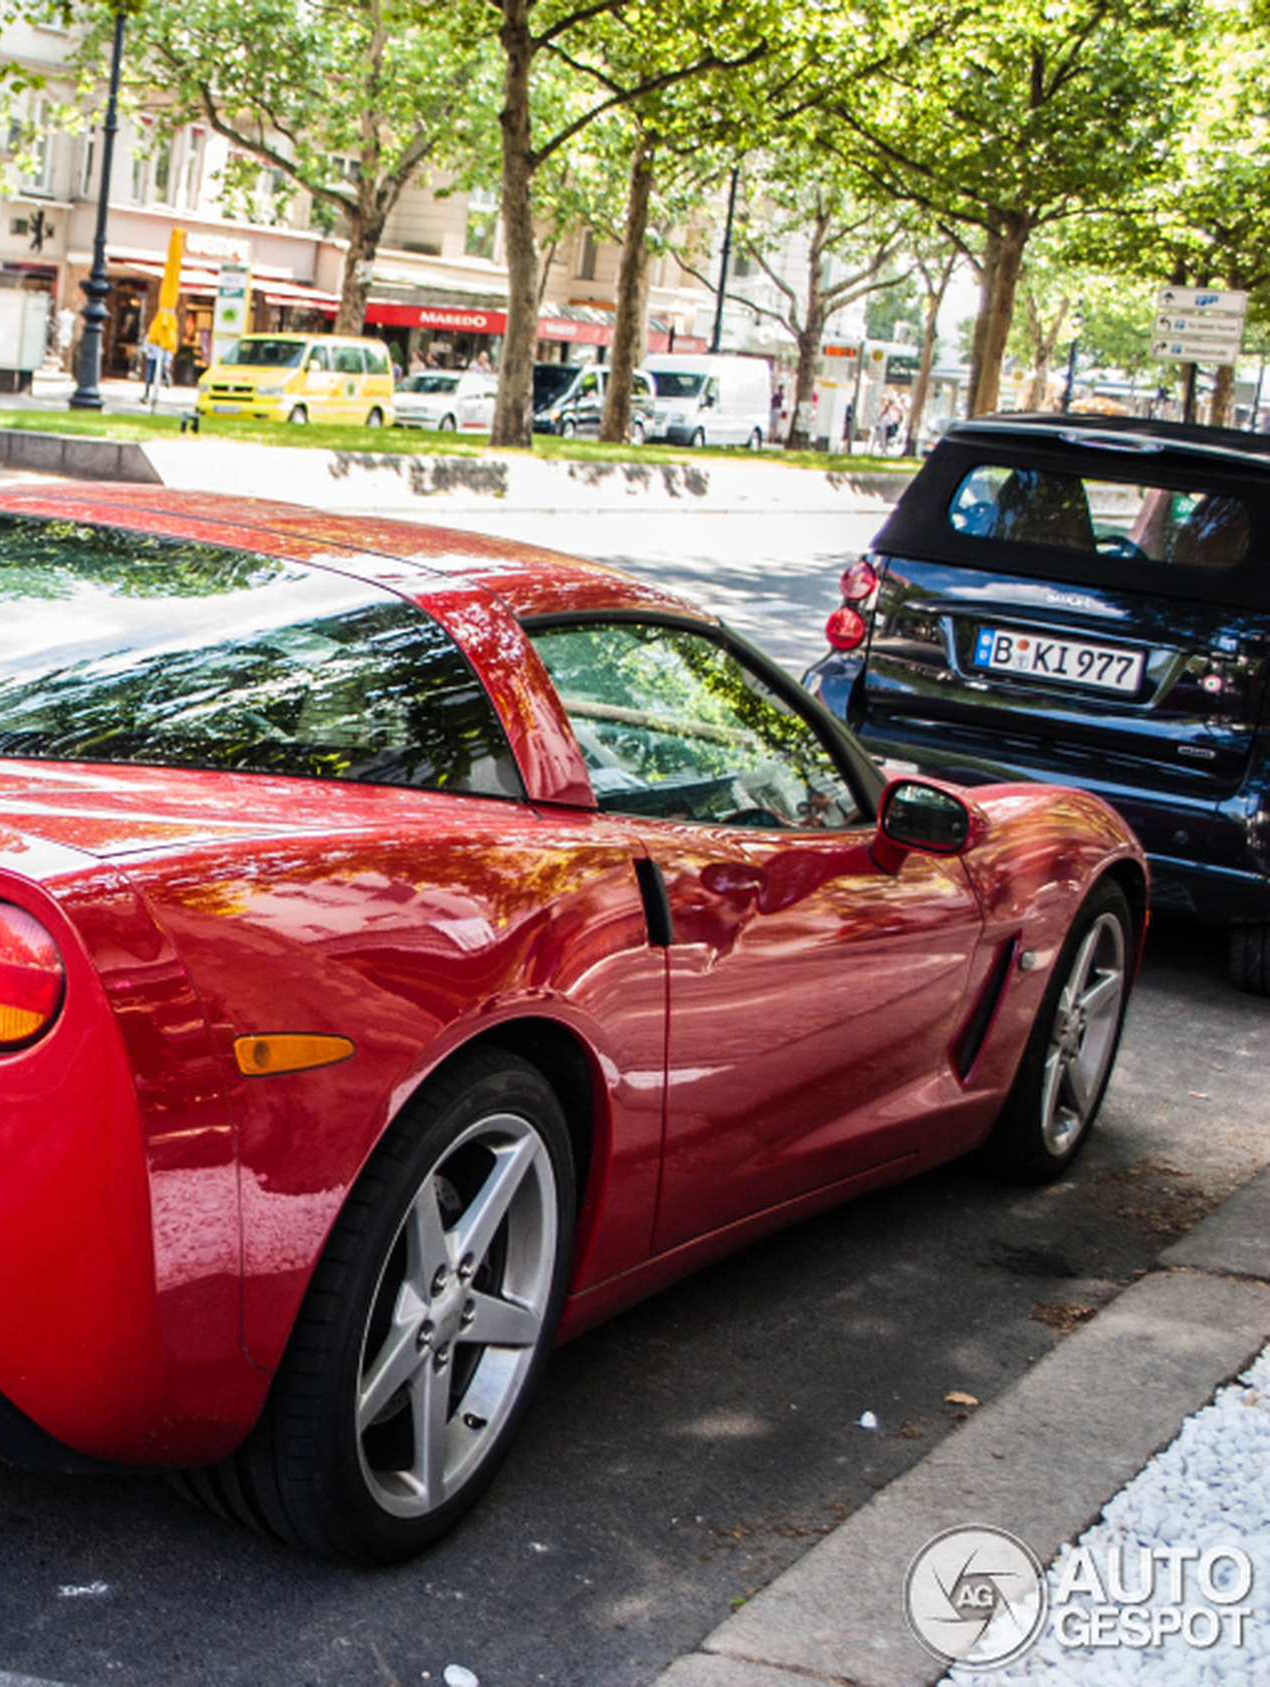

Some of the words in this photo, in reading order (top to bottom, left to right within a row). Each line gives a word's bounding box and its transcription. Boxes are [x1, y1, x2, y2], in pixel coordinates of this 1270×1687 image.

[419, 311, 488, 329] MAREDO
[993, 635, 1013, 664] B
[1032, 641, 1069, 675] KI
[1076, 649, 1134, 685] 977
